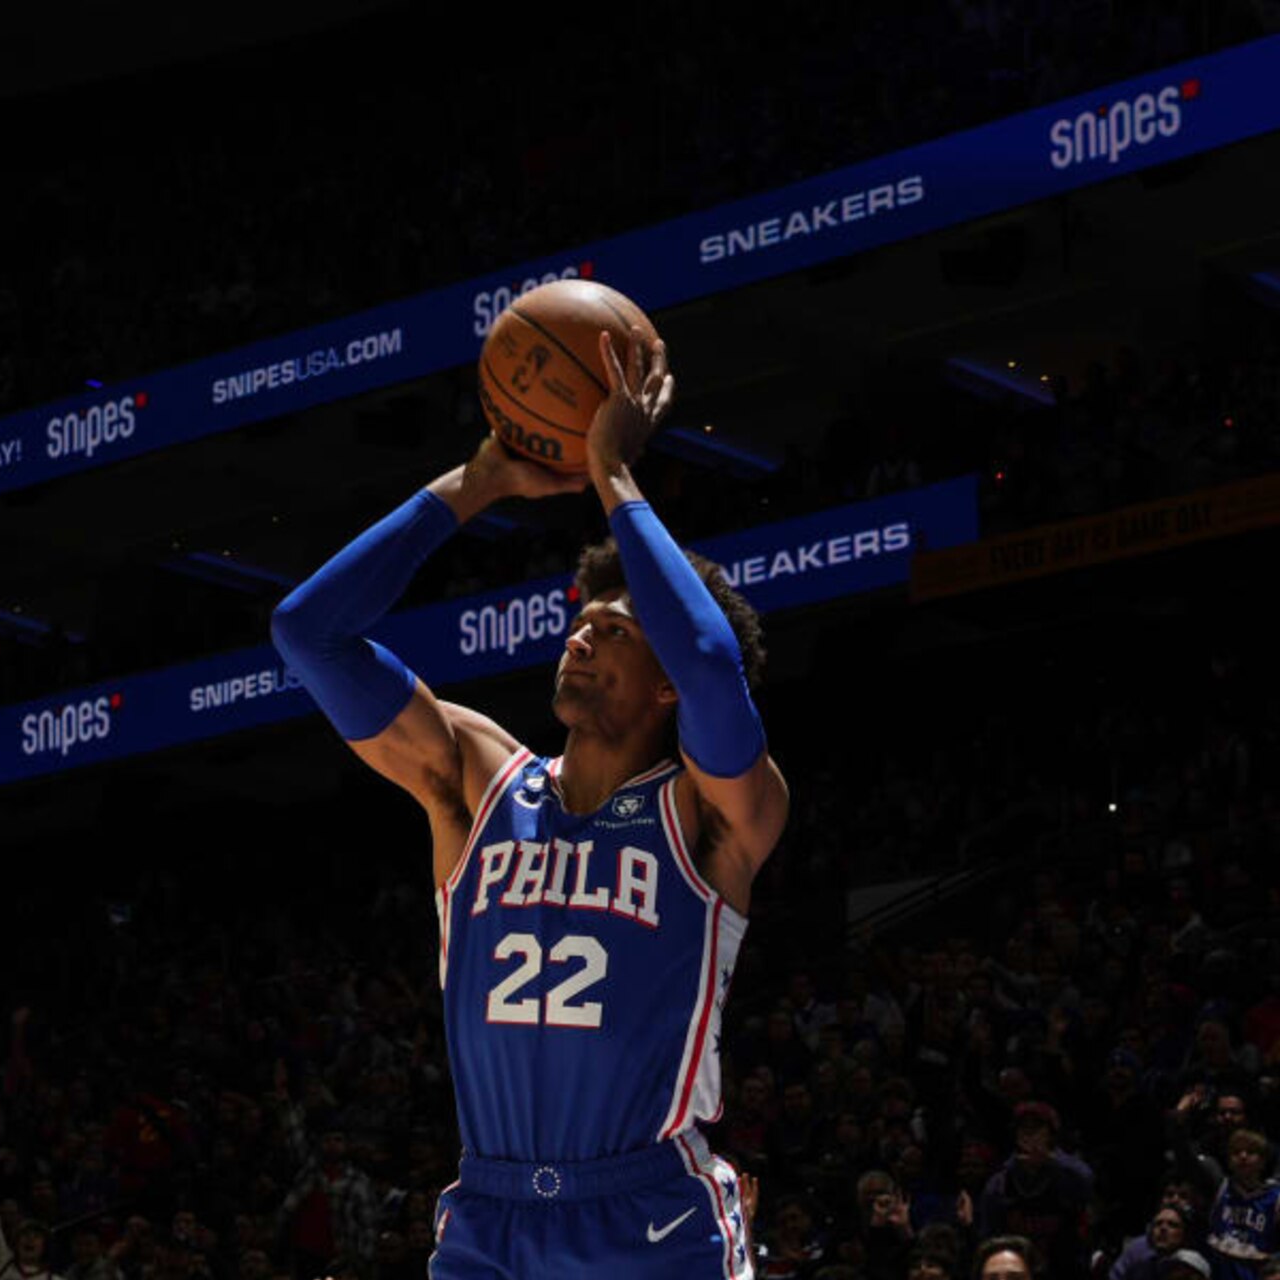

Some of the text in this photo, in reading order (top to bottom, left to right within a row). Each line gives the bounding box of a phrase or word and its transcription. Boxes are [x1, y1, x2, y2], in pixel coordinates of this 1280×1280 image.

[1051, 87, 1180, 168] snipes
[700, 176, 923, 262] SNEAKERS
[213, 329, 402, 403] SNIPESUSA.COM
[48, 397, 134, 458] snipes
[460, 590, 565, 655] snipes
[22, 697, 110, 757] snipes
[470, 837, 660, 929] PHILA
[485, 932, 609, 1029] 22
